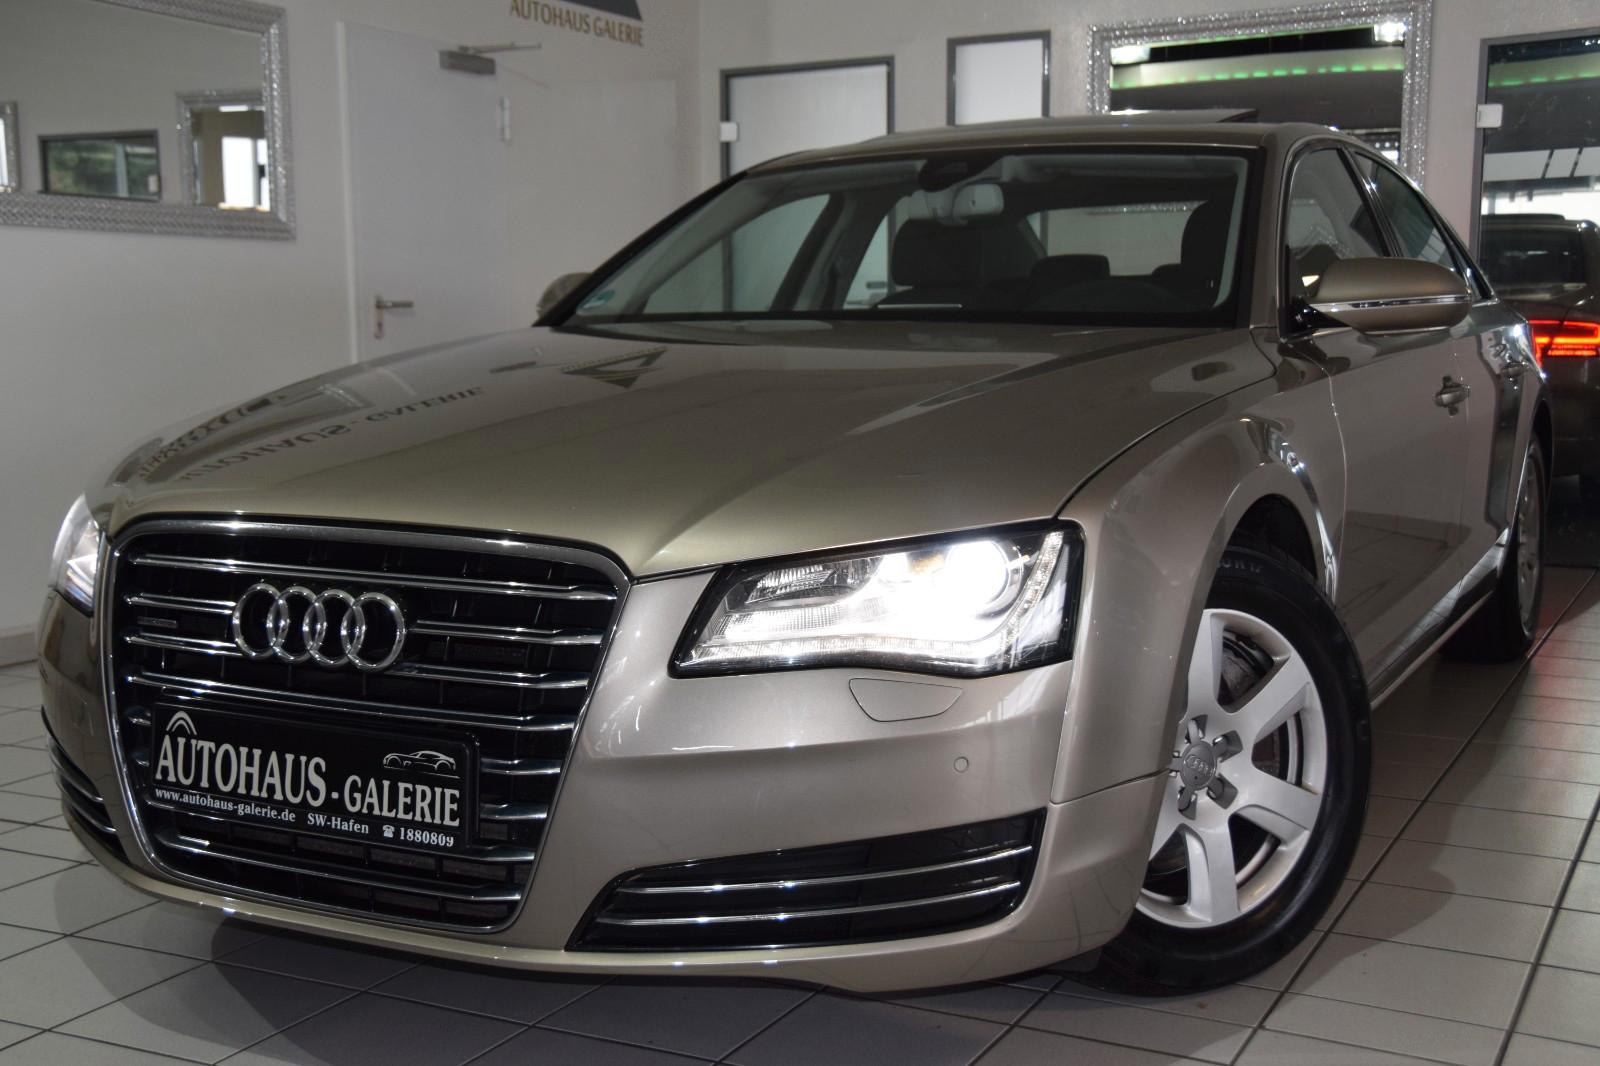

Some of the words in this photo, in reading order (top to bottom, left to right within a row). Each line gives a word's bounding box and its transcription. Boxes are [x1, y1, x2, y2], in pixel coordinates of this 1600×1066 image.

[510, 0, 591, 34] AUTOHAUS
[592, 16, 644, 47] GALERIE
[155, 734, 327, 807] AUTOHAUS
[343, 774, 460, 828] GALERIE
[155, 788, 297, 822] www.autohaus-galerie.de
[307, 812, 370, 835] SW-Hafen
[399, 827, 455, 847] 1880809
